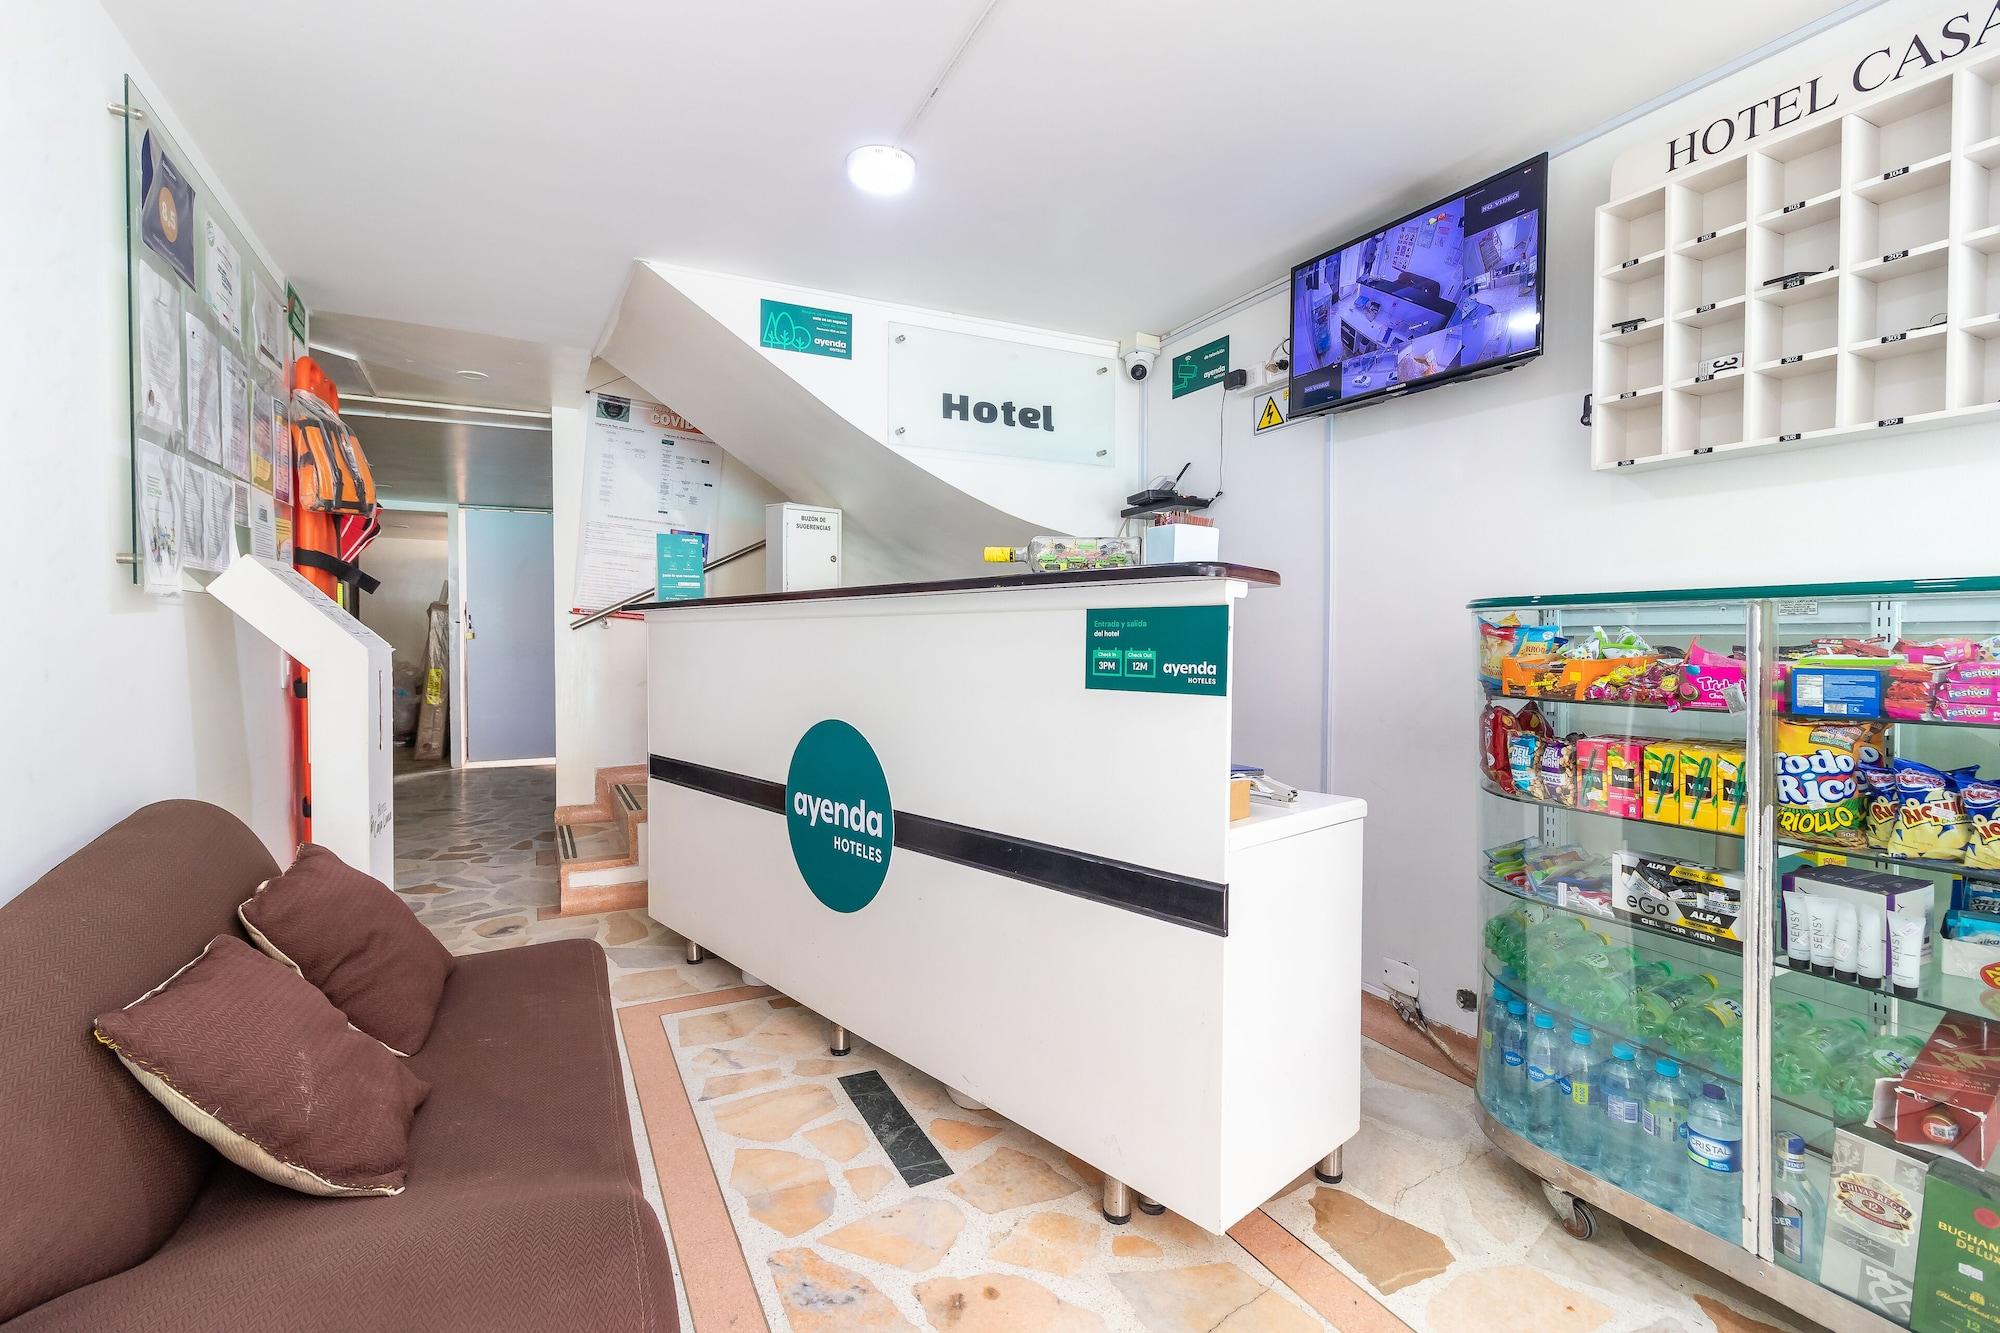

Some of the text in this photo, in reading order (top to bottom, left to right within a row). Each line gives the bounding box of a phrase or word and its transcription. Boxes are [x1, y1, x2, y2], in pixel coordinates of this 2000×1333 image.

[1664, 75, 1840, 174] HOTEL
[814, 337, 847, 349] ayenda
[1203, 365, 1226, 379] ayenda
[942, 392, 1055, 432] Hotel
[796, 522, 831, 531] SUGERENCIAS
[1094, 619, 1147, 629] Entrada y salida
[1098, 661, 1116, 671] 3PM
[1132, 661, 1148, 671] 12M
[1162, 661, 1217, 677] ayenda
[1187, 677, 1217, 685] HOTELES
[1948, 689, 1989, 698] Festival
[1946, 708, 1986, 717] Festival
[1613, 774, 1633, 783] Valle
[1777, 772, 1857, 804] Rico
[793, 791, 883, 838] ayenda
[1777, 806, 1854, 833] RIOLLO
[833, 835, 883, 864] HOTELES
[1646, 862, 1666, 872] ALFA
[1675, 869, 1700, 879] CONTROL
[1626, 895, 1670, 917] eGo
[1690, 910, 1722, 926] ALFA
[1790, 909, 1801, 944] SENSY
[1641, 917, 1716, 943] GEL FOR MEN
[1812, 915, 1823, 950] SENSY
[1892, 930, 1902, 968] SENSY
[1690, 1137, 1731, 1156] CRISTAL
[1840, 1181, 1875, 1199] CHIVAS
[1877, 1195, 1909, 1217] REGAL
[1868, 1202, 1878, 1212] 12
